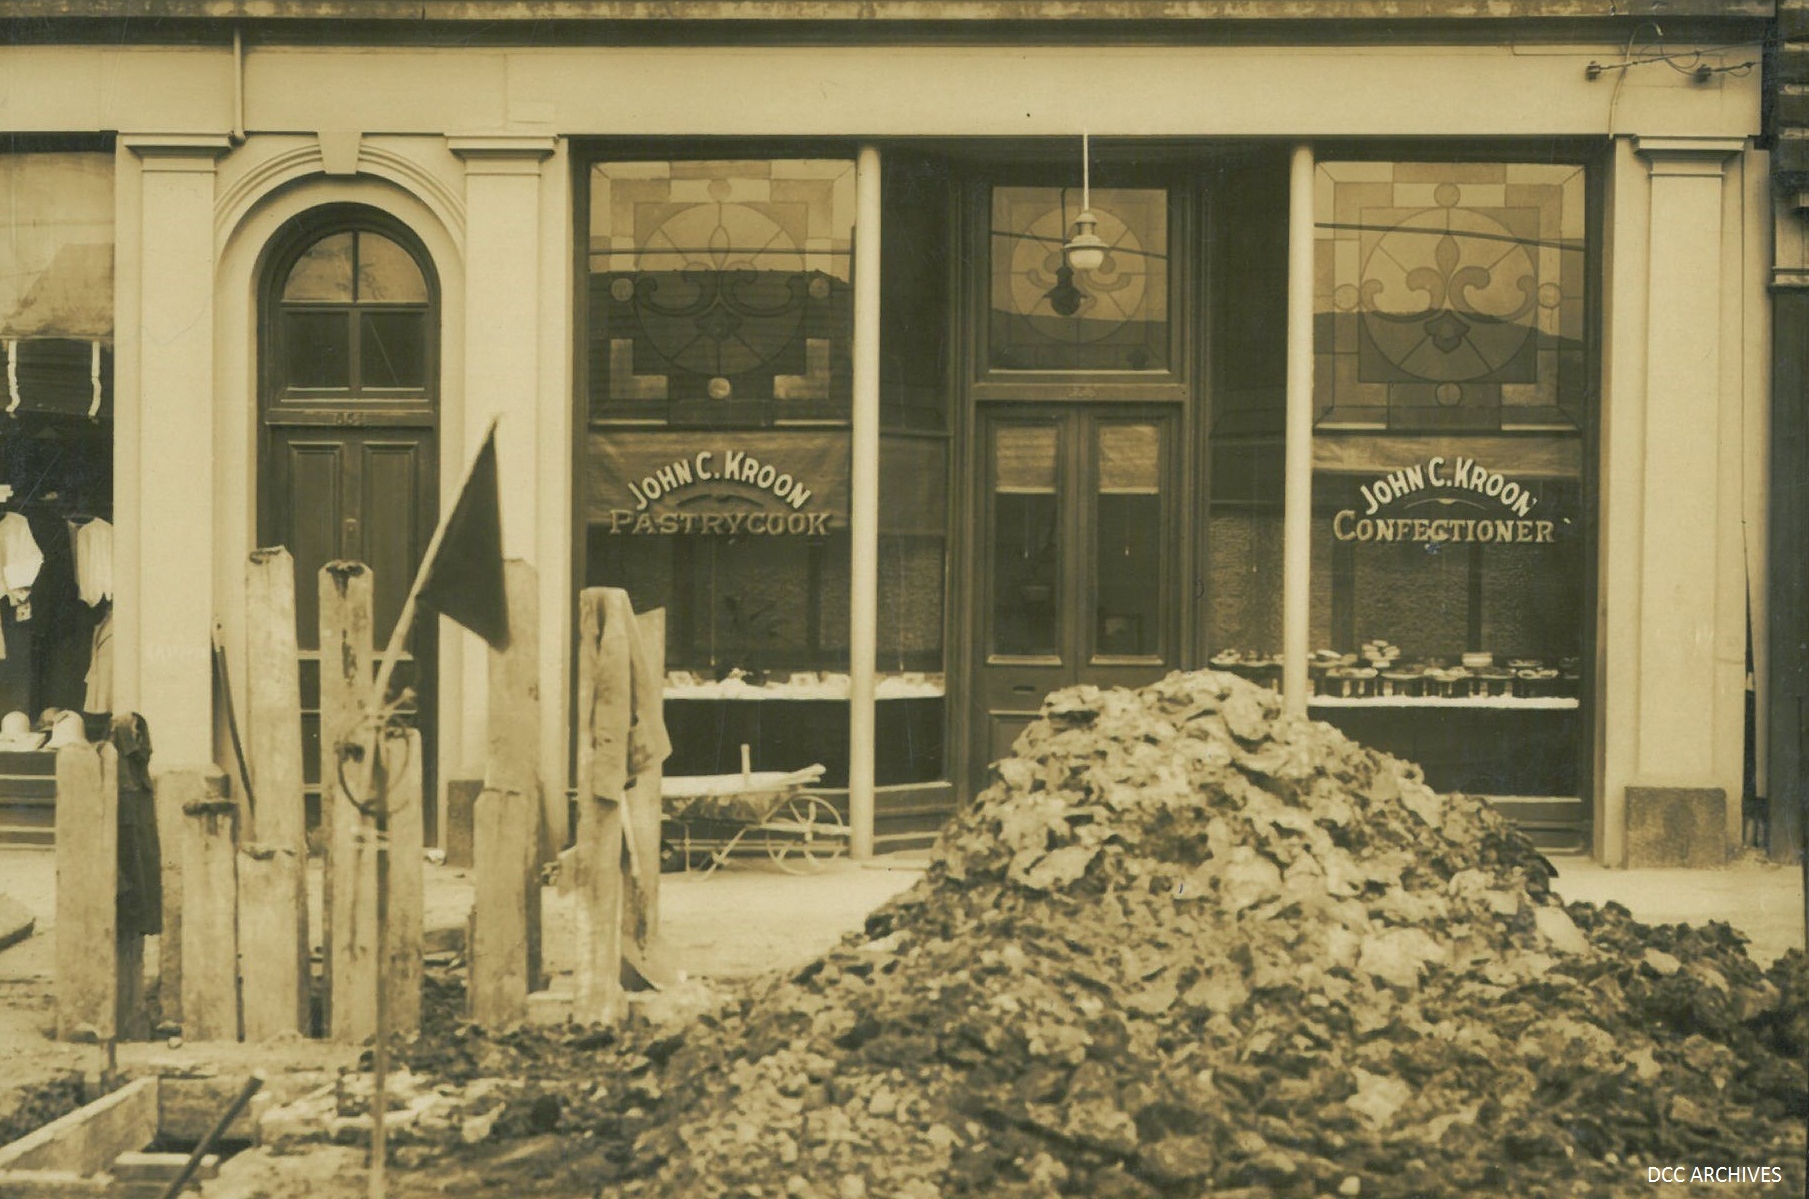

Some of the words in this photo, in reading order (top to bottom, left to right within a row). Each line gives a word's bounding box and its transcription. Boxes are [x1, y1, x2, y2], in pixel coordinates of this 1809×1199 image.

[628, 458, 694, 511] JOHN
[695, 451, 720, 481] C.
[724, 450, 812, 510] KROON
[1360, 463, 1425, 516] JOHN
[1428, 456, 1452, 488] C.
[1455, 456, 1537, 518] KROON
[608, 509, 832, 536] PASTRYCOOK
[1333, 509, 1556, 543] CONFECTIONER
